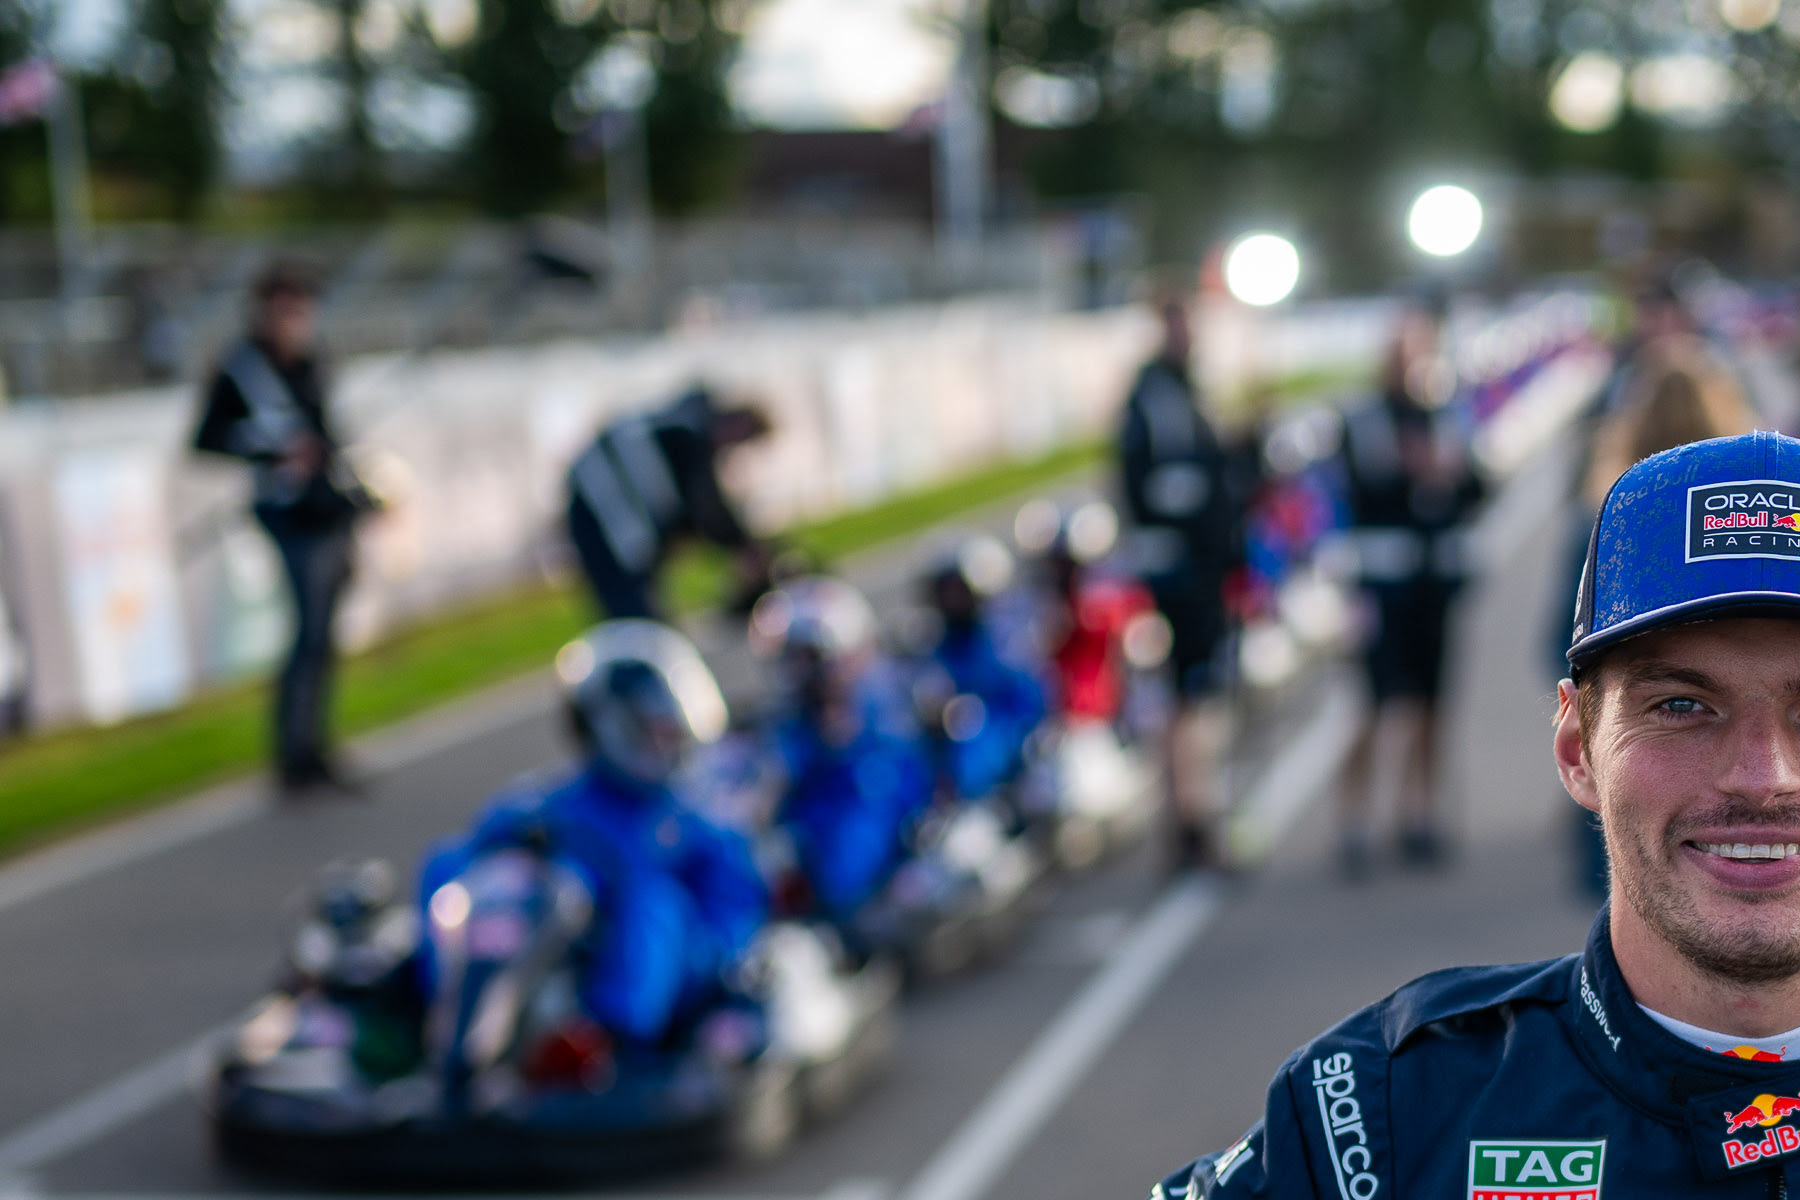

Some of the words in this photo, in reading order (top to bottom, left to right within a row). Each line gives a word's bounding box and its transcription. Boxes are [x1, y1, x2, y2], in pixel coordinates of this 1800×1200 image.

[1703, 512, 1735, 531] Red
[1736, 510, 1768, 529] Bull
[1722, 1126, 1779, 1169] Red
[1482, 1150, 1595, 1183] TAG
